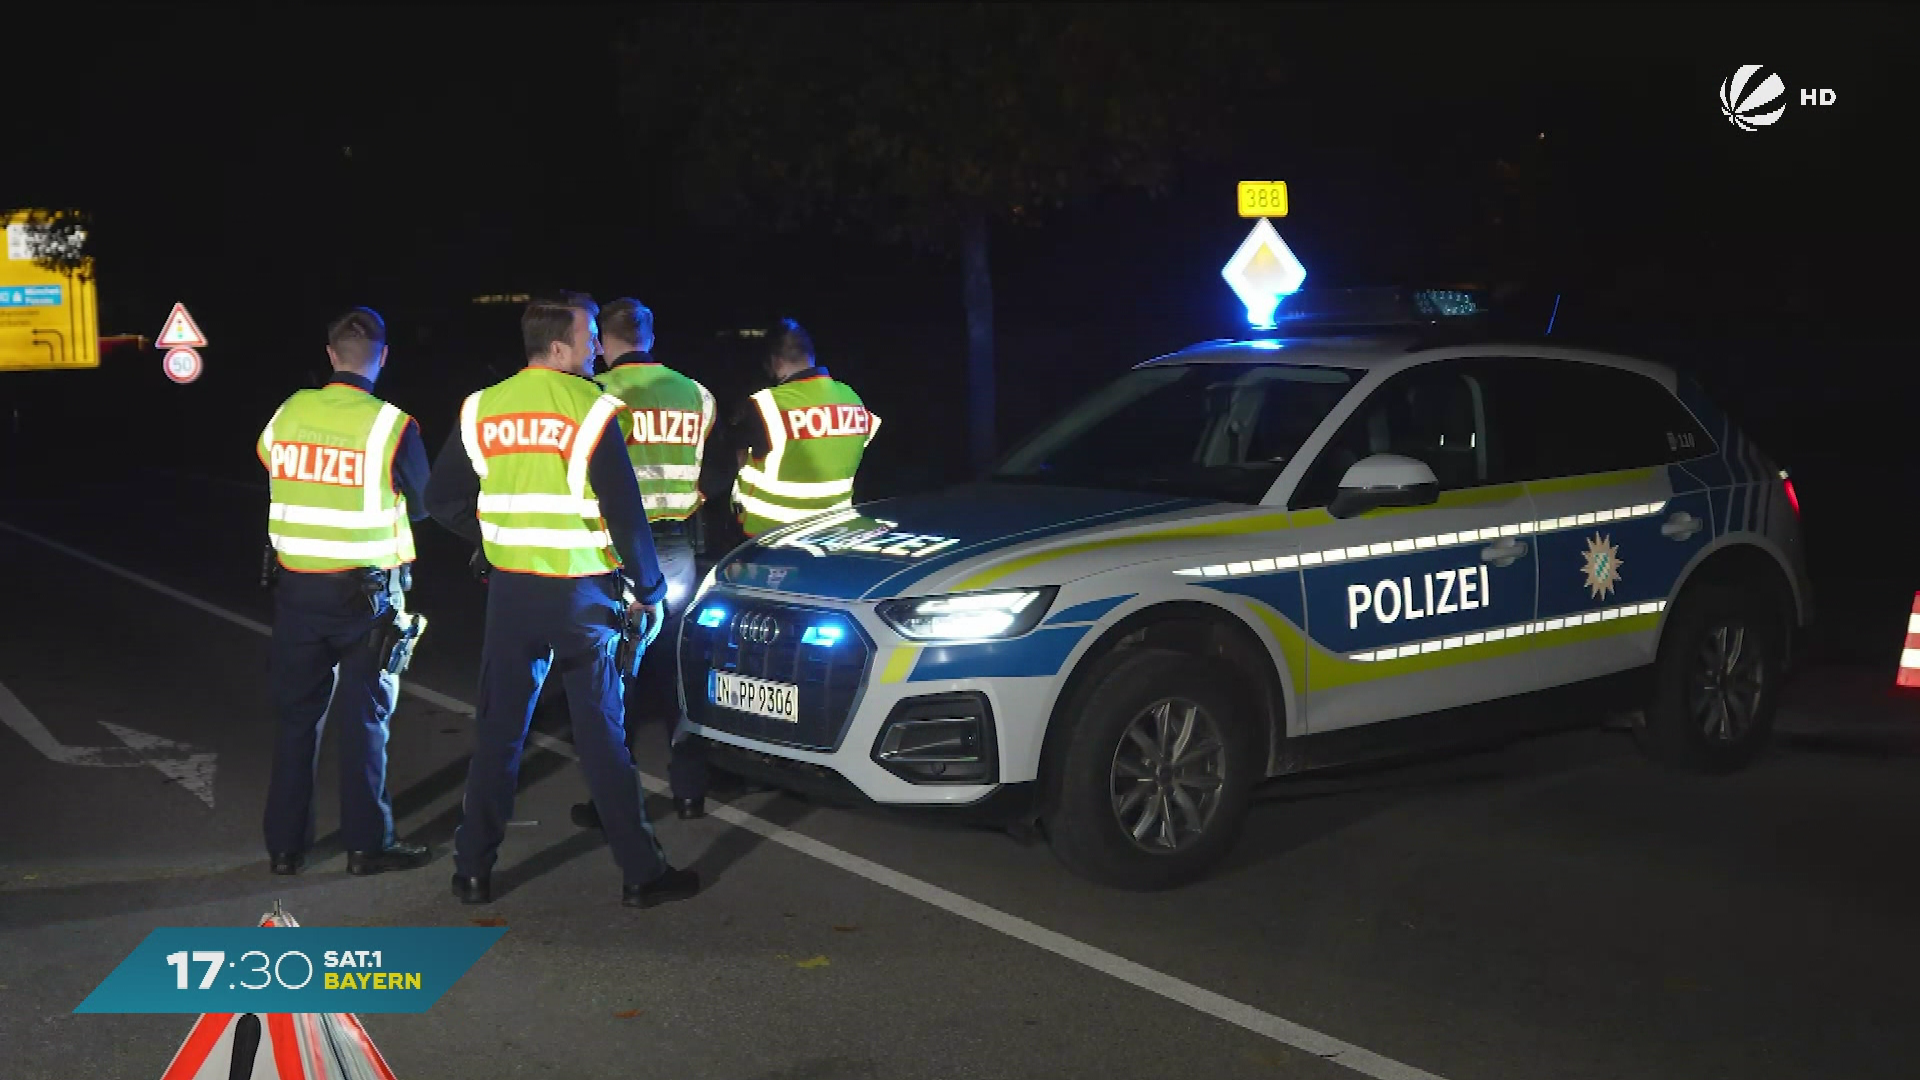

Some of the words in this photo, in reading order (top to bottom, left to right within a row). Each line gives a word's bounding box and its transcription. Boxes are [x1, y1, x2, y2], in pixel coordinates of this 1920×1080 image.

[1246, 188, 1281, 208] 388
[172, 356, 192, 372] 50
[483, 418, 574, 450] POLIZEI
[633, 410, 700, 444] OLIZEI
[787, 405, 870, 439] POLIZEI
[271, 445, 364, 485] POLIZEI
[1347, 564, 1491, 630] POLIZEI
[717, 676, 730, 704] IN
[740, 681, 755, 709] PP
[759, 685, 793, 716] 9306
